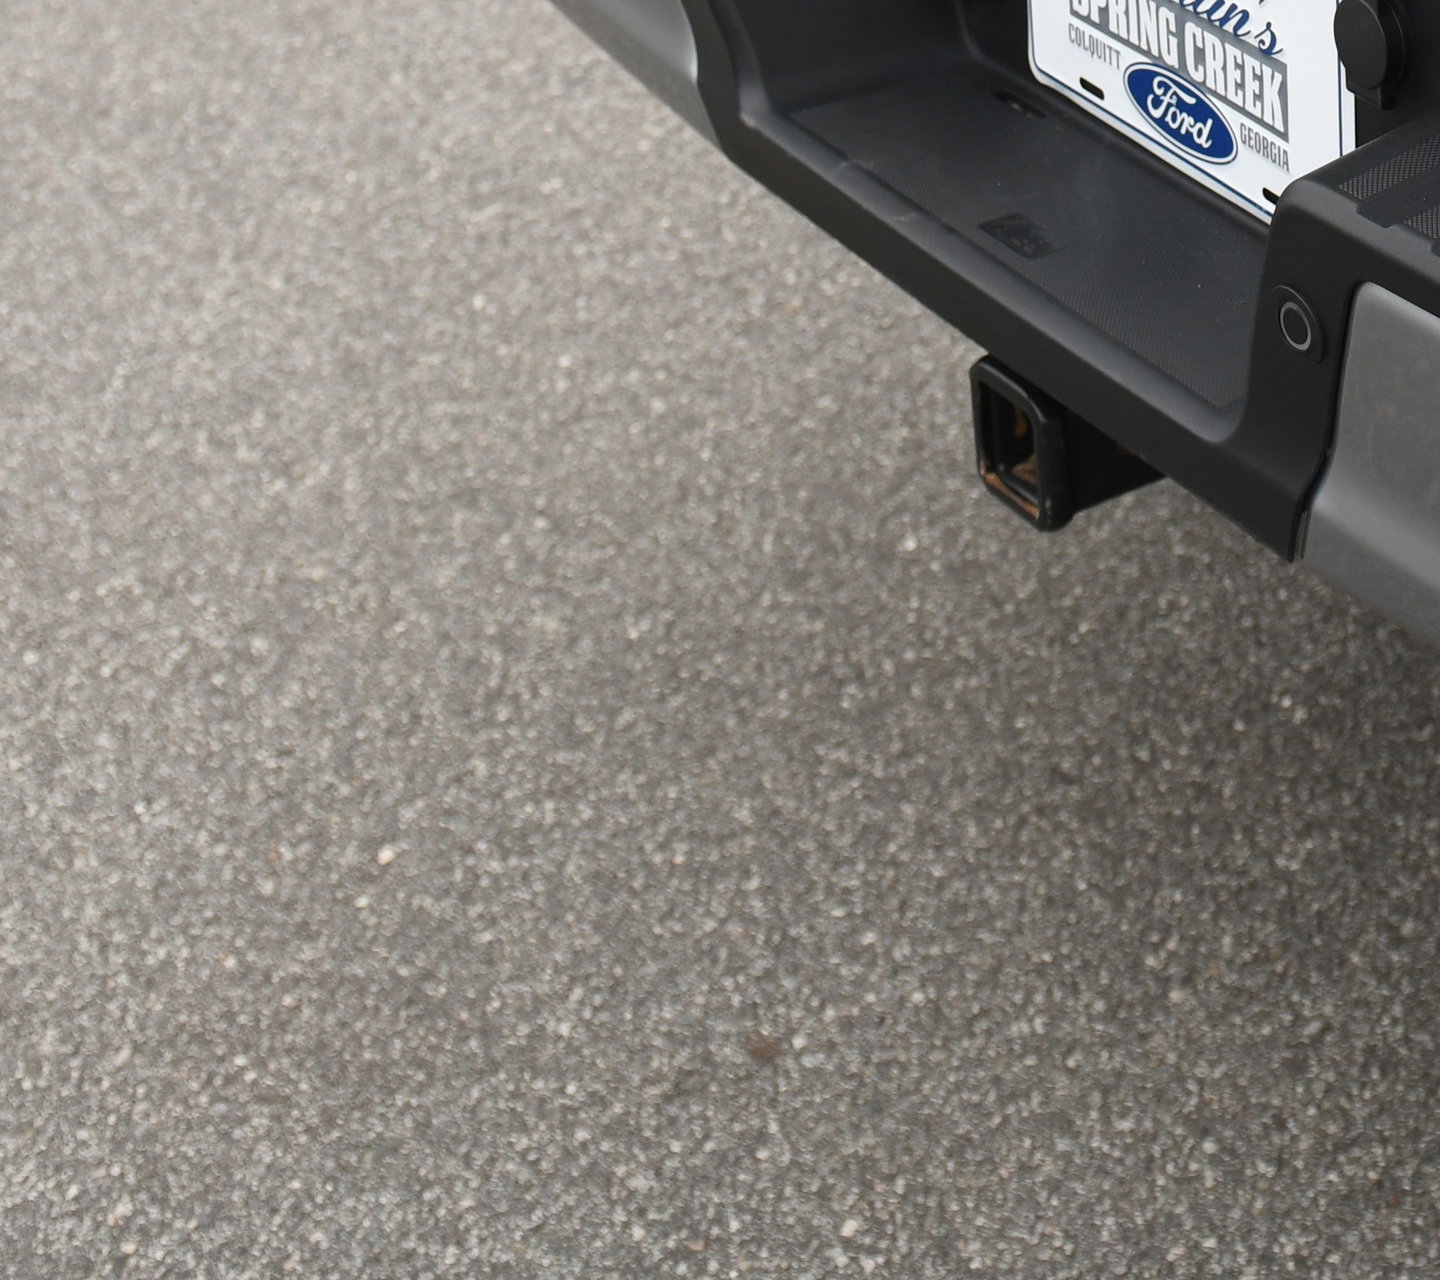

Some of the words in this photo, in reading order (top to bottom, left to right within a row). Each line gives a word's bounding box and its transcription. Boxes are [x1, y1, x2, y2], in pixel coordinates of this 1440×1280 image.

[1067, 22, 1122, 71] COLQUITT
[1183, 21, 1286, 134] CREEK
[1146, 75, 1214, 149] Ford
[1239, 121, 1291, 173] GEORGIA
